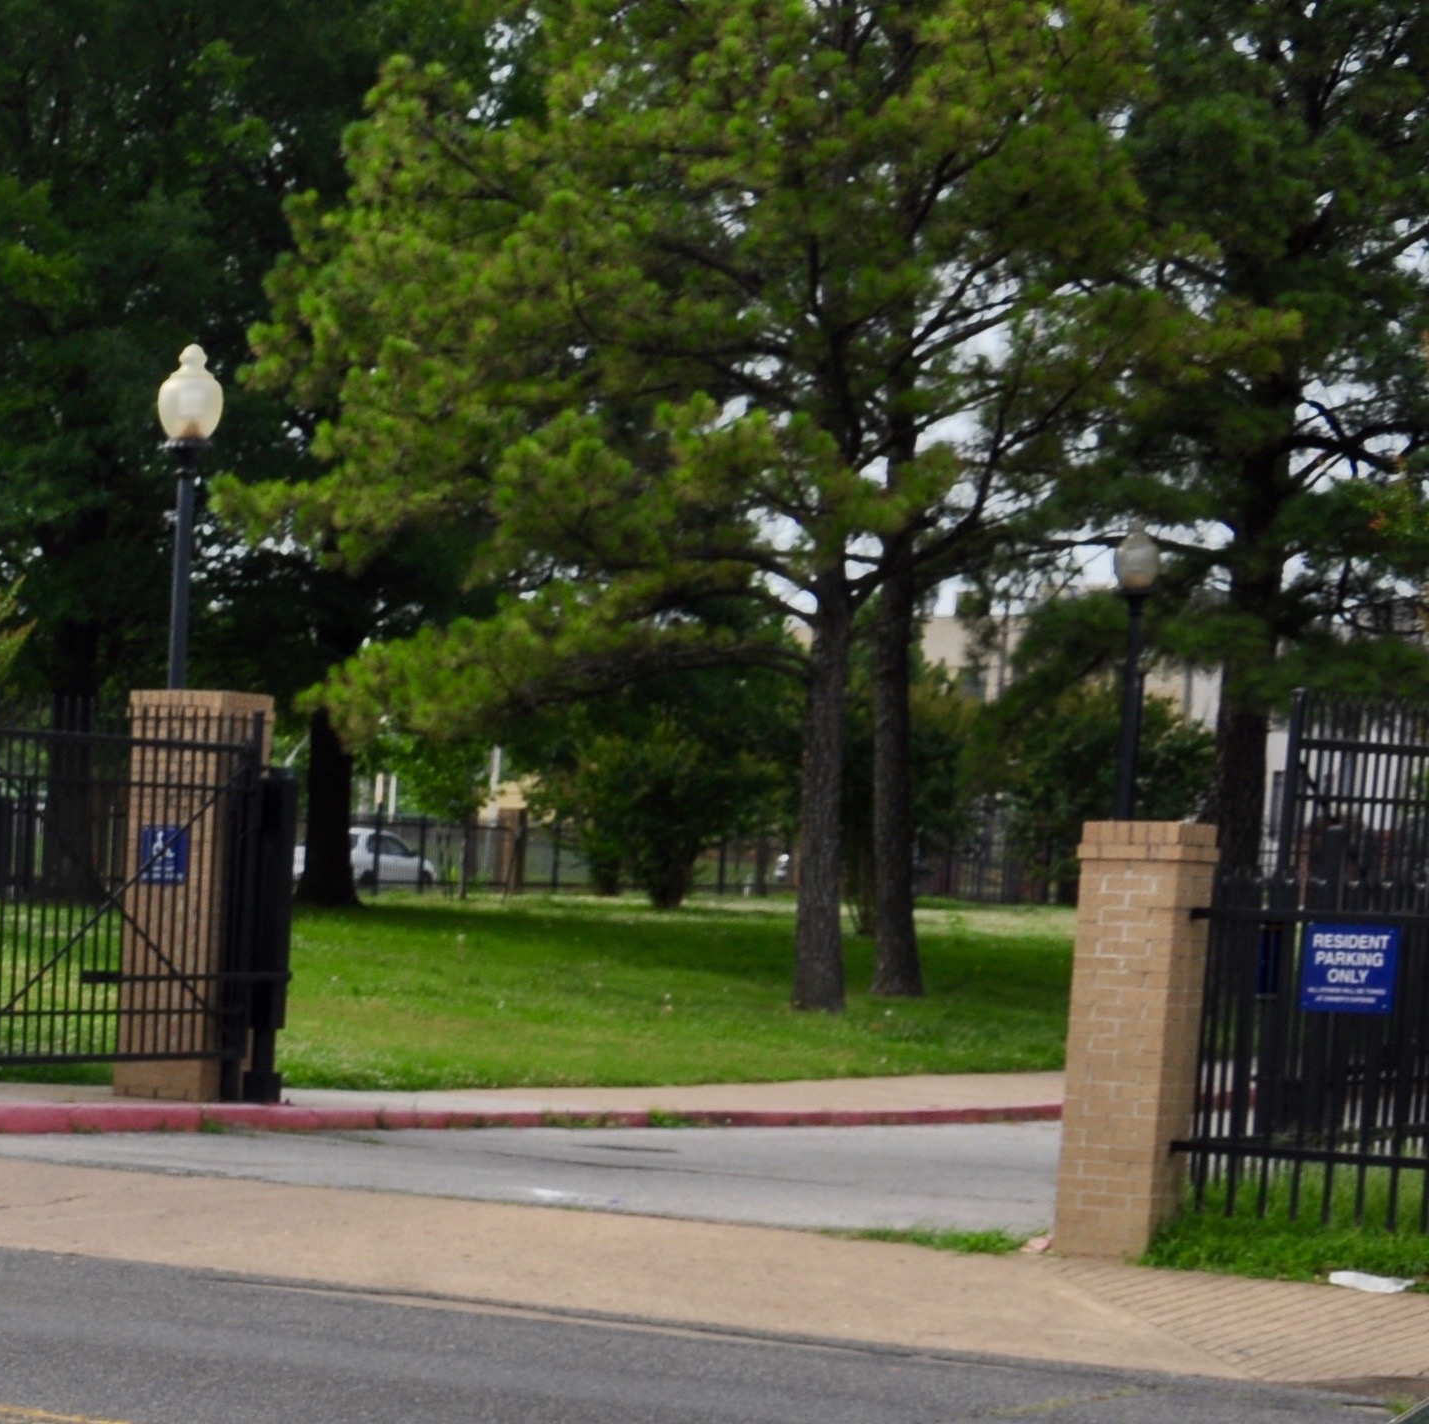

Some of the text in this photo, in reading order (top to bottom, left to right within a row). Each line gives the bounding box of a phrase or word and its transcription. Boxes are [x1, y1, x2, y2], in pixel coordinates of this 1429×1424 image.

[1312, 933, 1391, 950] RESIDENT
[1315, 951, 1384, 967] PARKING
[1327, 968, 1369, 984] ONLY
